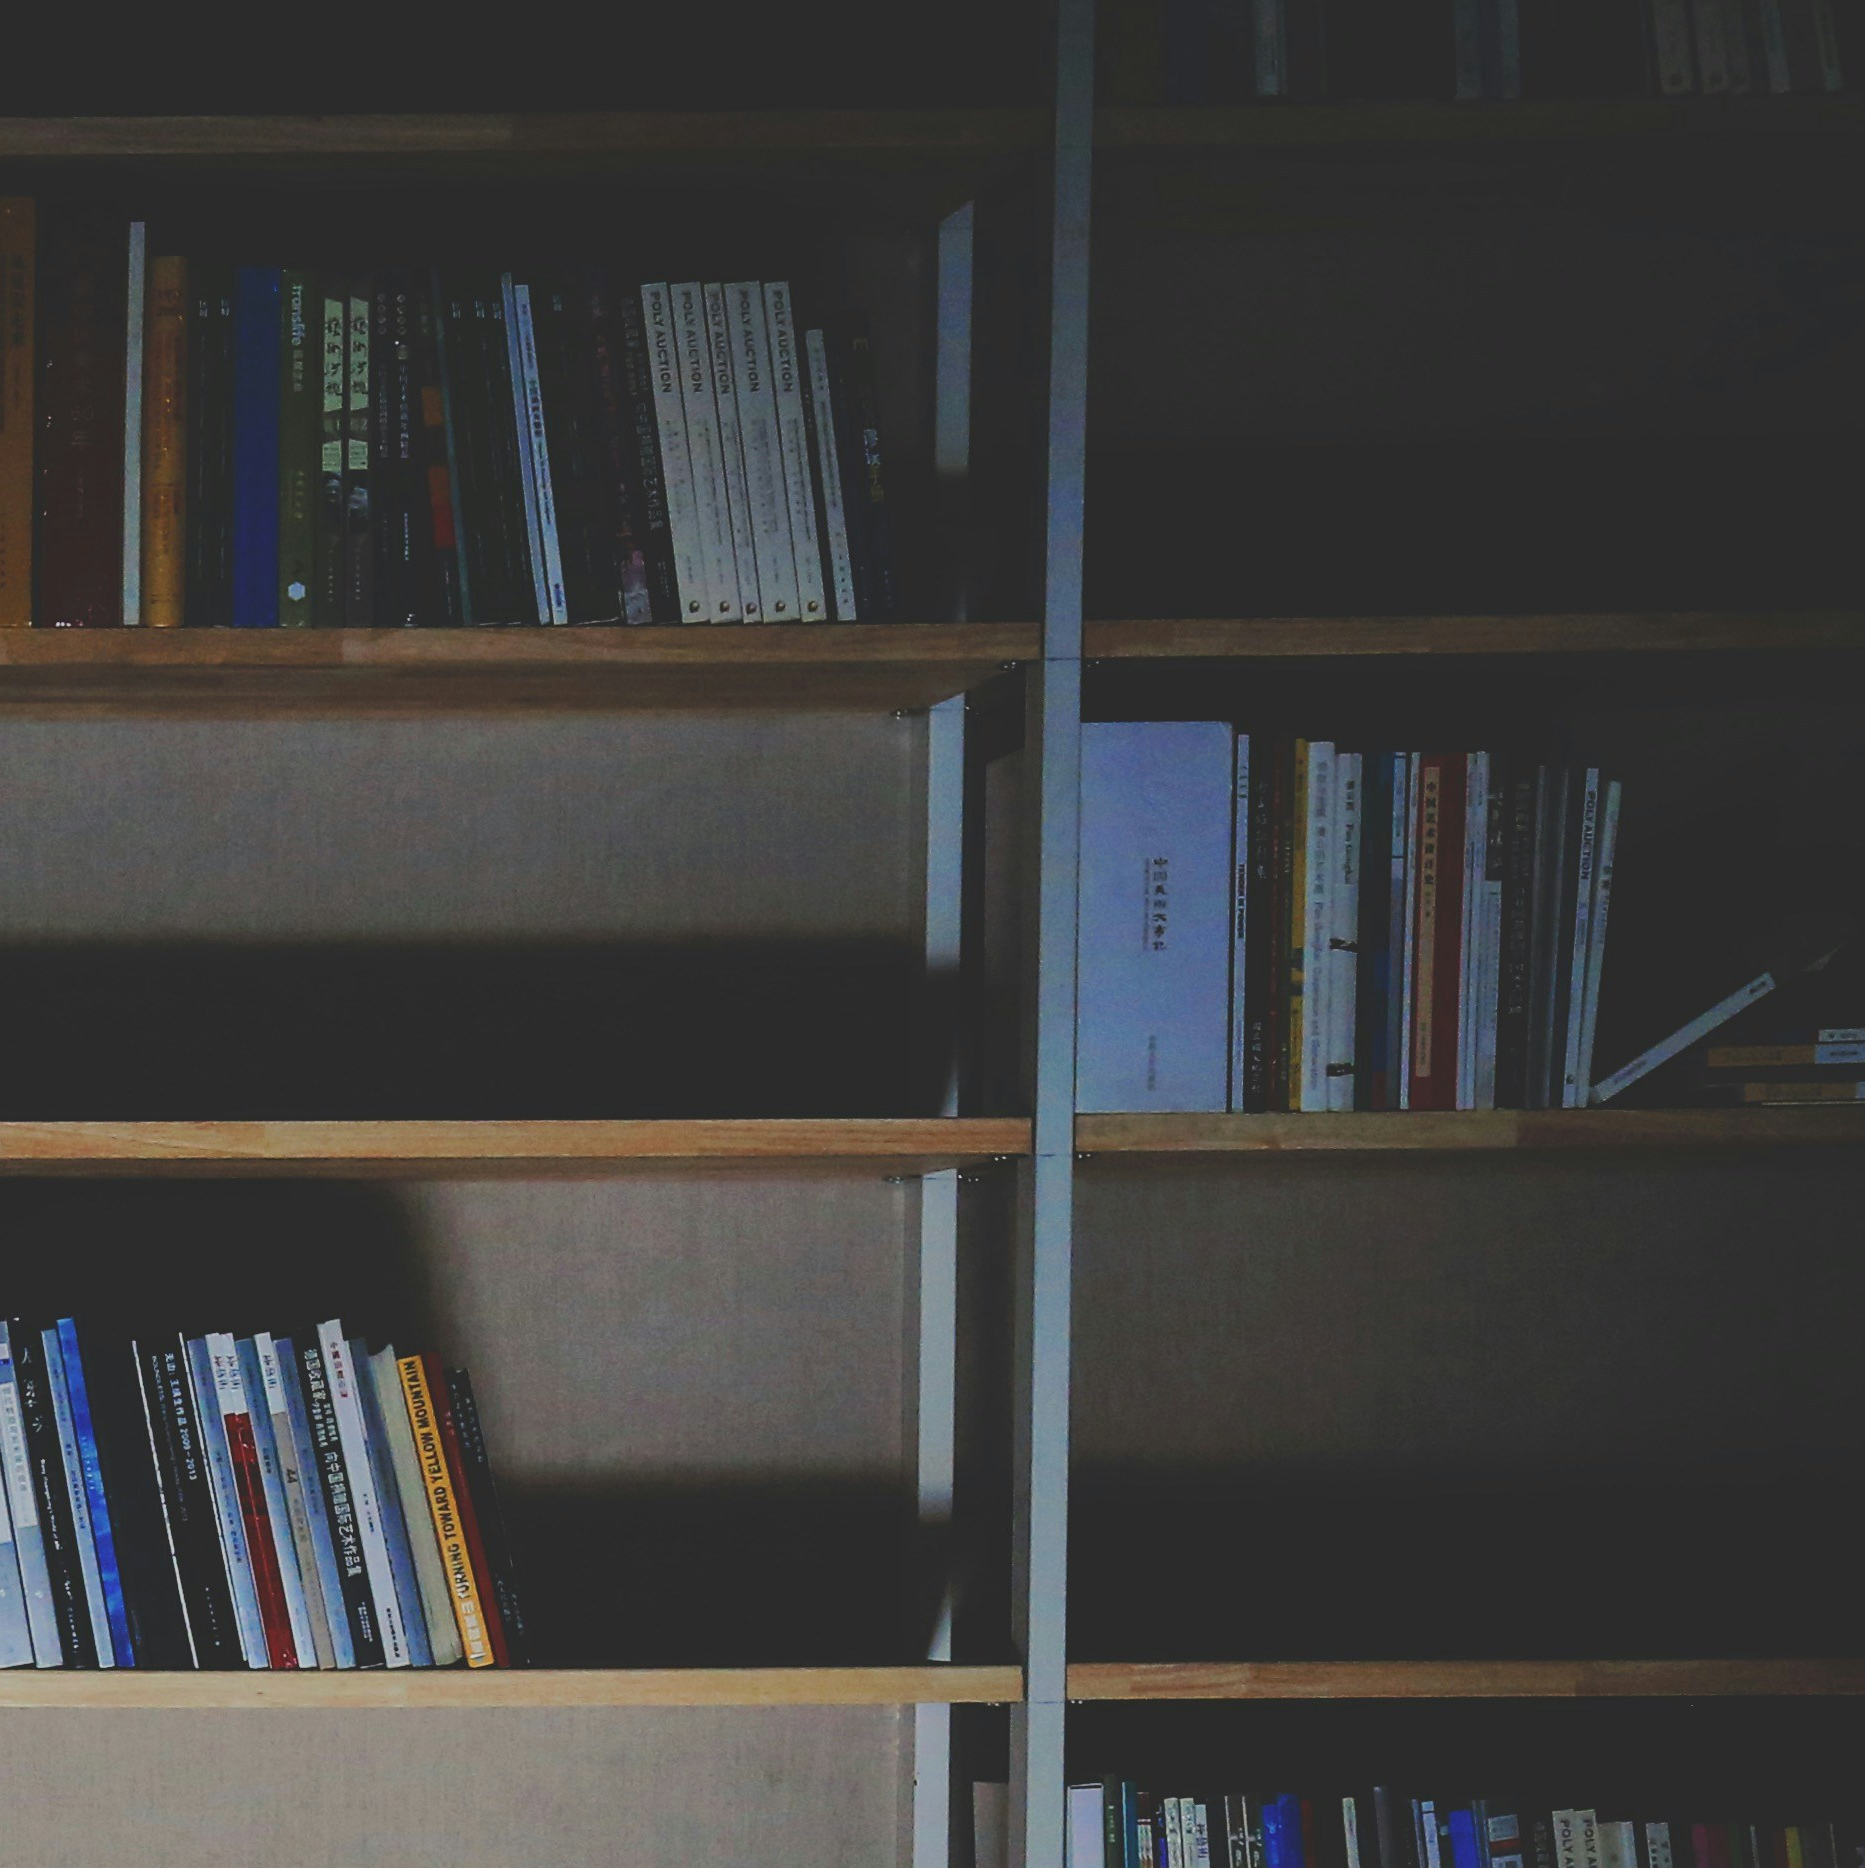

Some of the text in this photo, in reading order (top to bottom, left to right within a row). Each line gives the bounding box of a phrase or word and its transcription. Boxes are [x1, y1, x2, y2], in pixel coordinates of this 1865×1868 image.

[403, 1360, 431, 1430] MOUNTAIN
[422, 1432, 443, 1483] YELLOW
[433, 1486, 457, 1540] TOWARD
